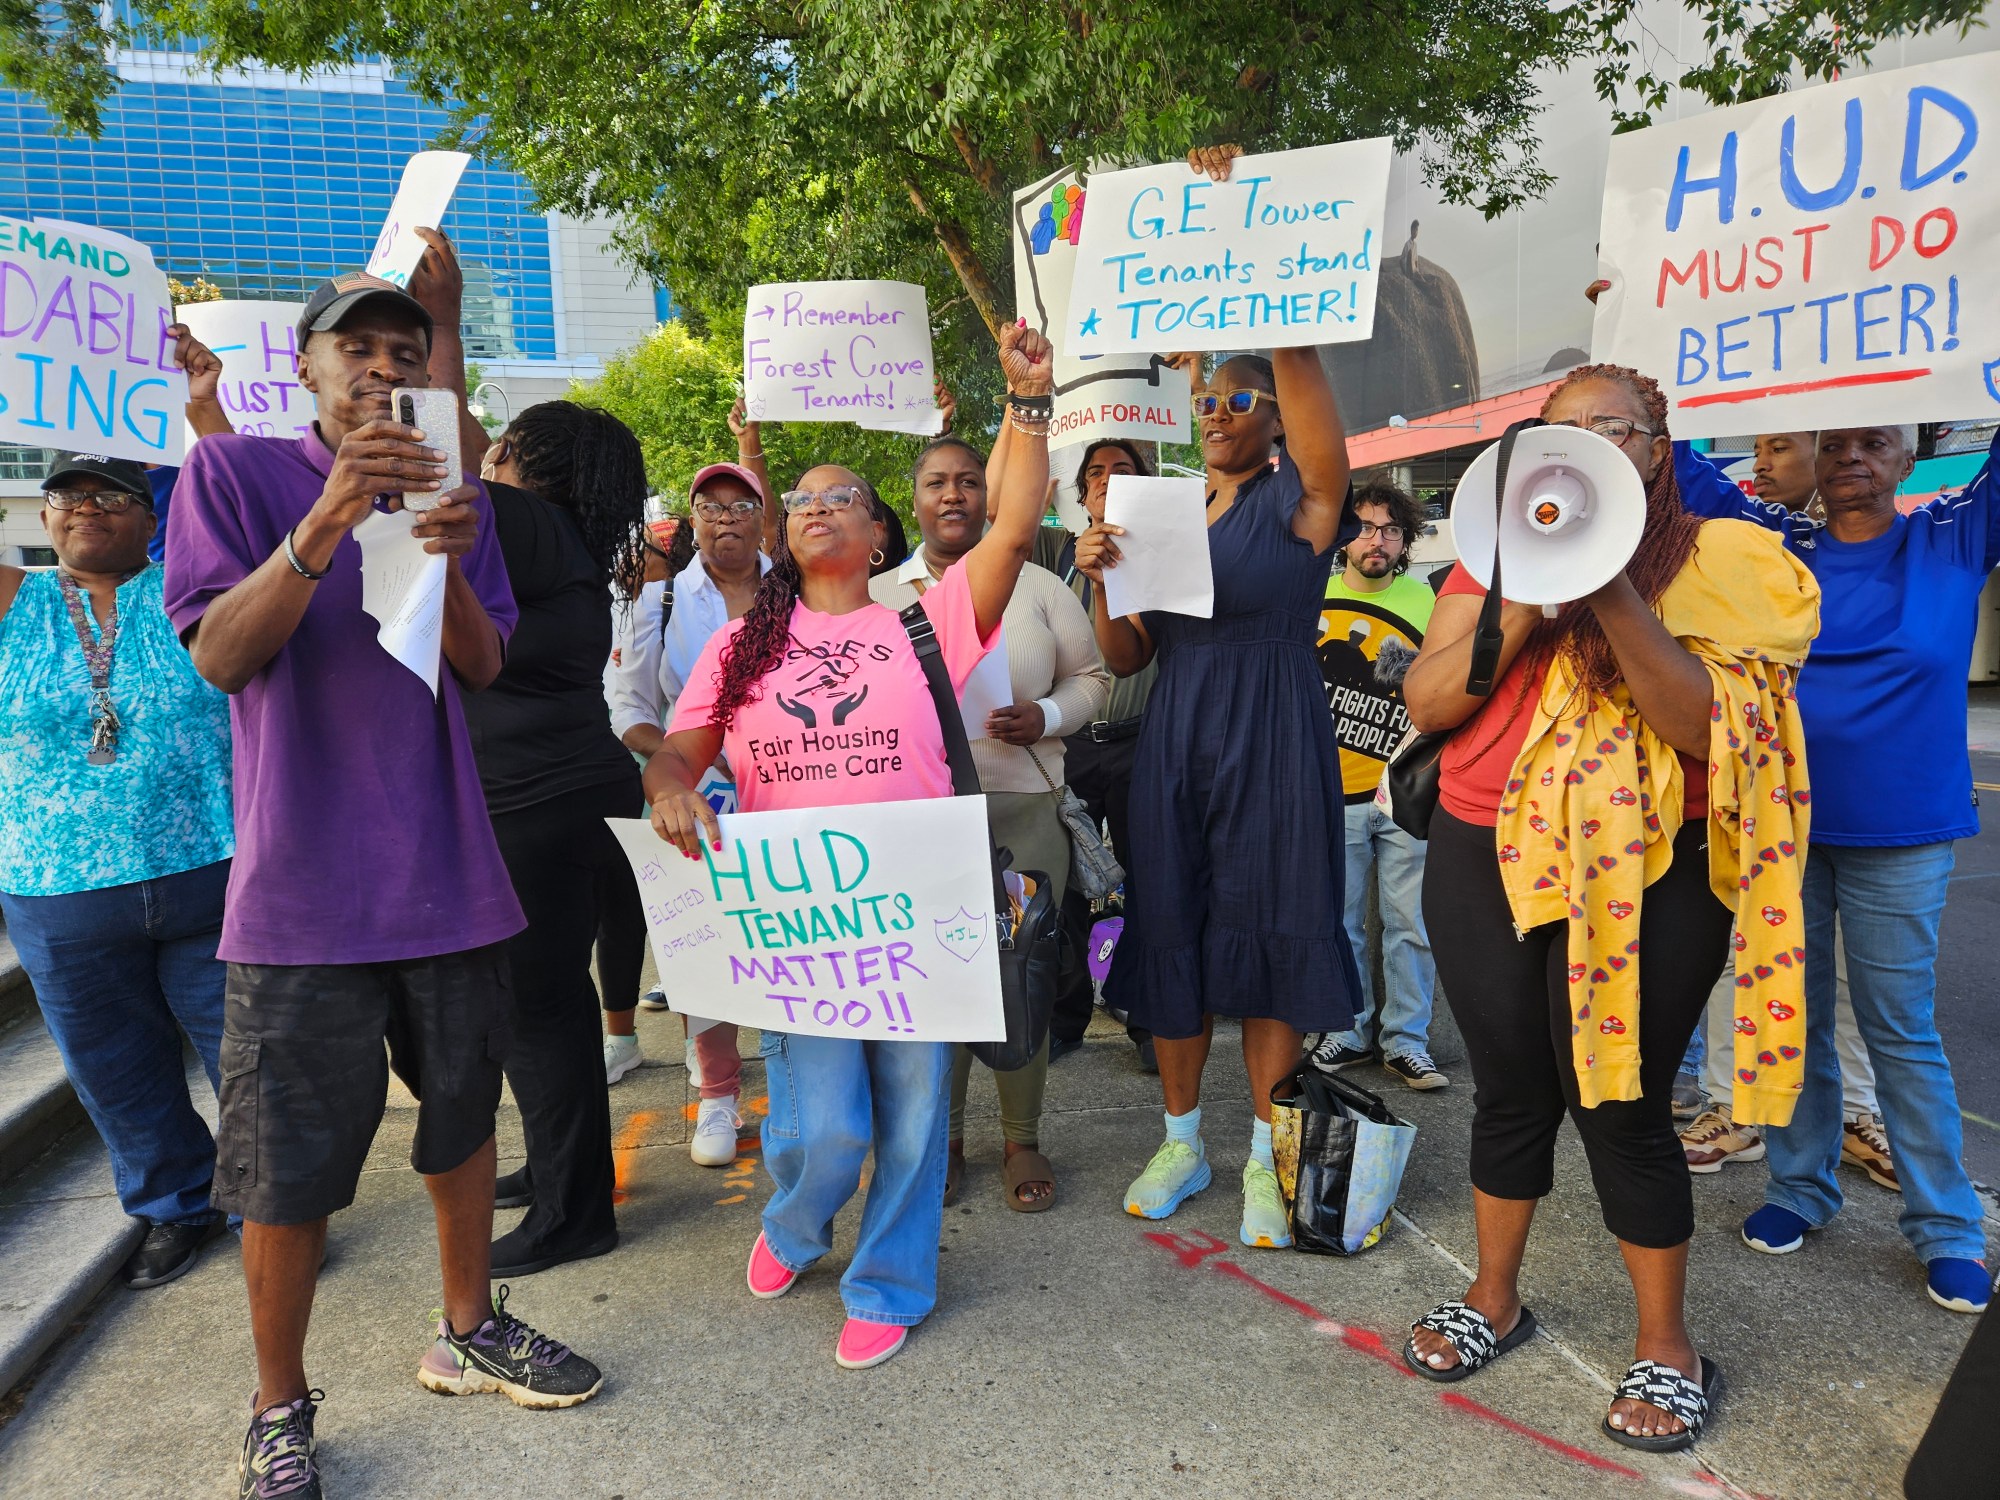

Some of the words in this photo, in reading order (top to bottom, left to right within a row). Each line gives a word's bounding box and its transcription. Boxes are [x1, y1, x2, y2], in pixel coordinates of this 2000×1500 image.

[1665, 85, 1979, 232] H.U.D.
[1127, 181, 1217, 241] G.E.
[1236, 175, 1356, 229] Tower
[1102, 248, 1256, 293] Tenants
[1276, 228, 1373, 280] stand
[1656, 223, 1831, 309] MUST
[1868, 206, 1959, 272] DO
[783, 290, 906, 327] Remember
[1116, 281, 1358, 340] TOGETHER!
[1676, 274, 1960, 387] BETTER!
[748, 338, 837, 380] Forest
[849, 334, 924, 378] Cove
[0, 352, 168, 450] ING
[216, 380, 300, 414] UST
[791, 379, 895, 410] Tenants!
[1047, 407, 1096, 439] ORGIA
[1101, 403, 1141, 423] FOR
[1144, 406, 1177, 427] ALL
[1329, 685, 1391, 725] FIGHTS
[1388, 703, 1412, 732] FO
[748, 736, 793, 762] Fair
[801, 726, 900, 753] Housing
[1335, 716, 1399, 758] PEOPLE
[757, 765, 774, 784] &
[774, 761, 838, 783] Home
[845, 754, 903, 777] Care
[636, 853, 668, 887] HEY
[698, 828, 871, 903] HUD
[648, 888, 705, 926] ELECTED
[722, 891, 916, 950] TENANTS
[663, 924, 722, 958] OFFICIALS,
[945, 926, 979, 943] HJL
[728, 941, 929, 990] MATTER
[765, 989, 917, 1034] TOO!!
